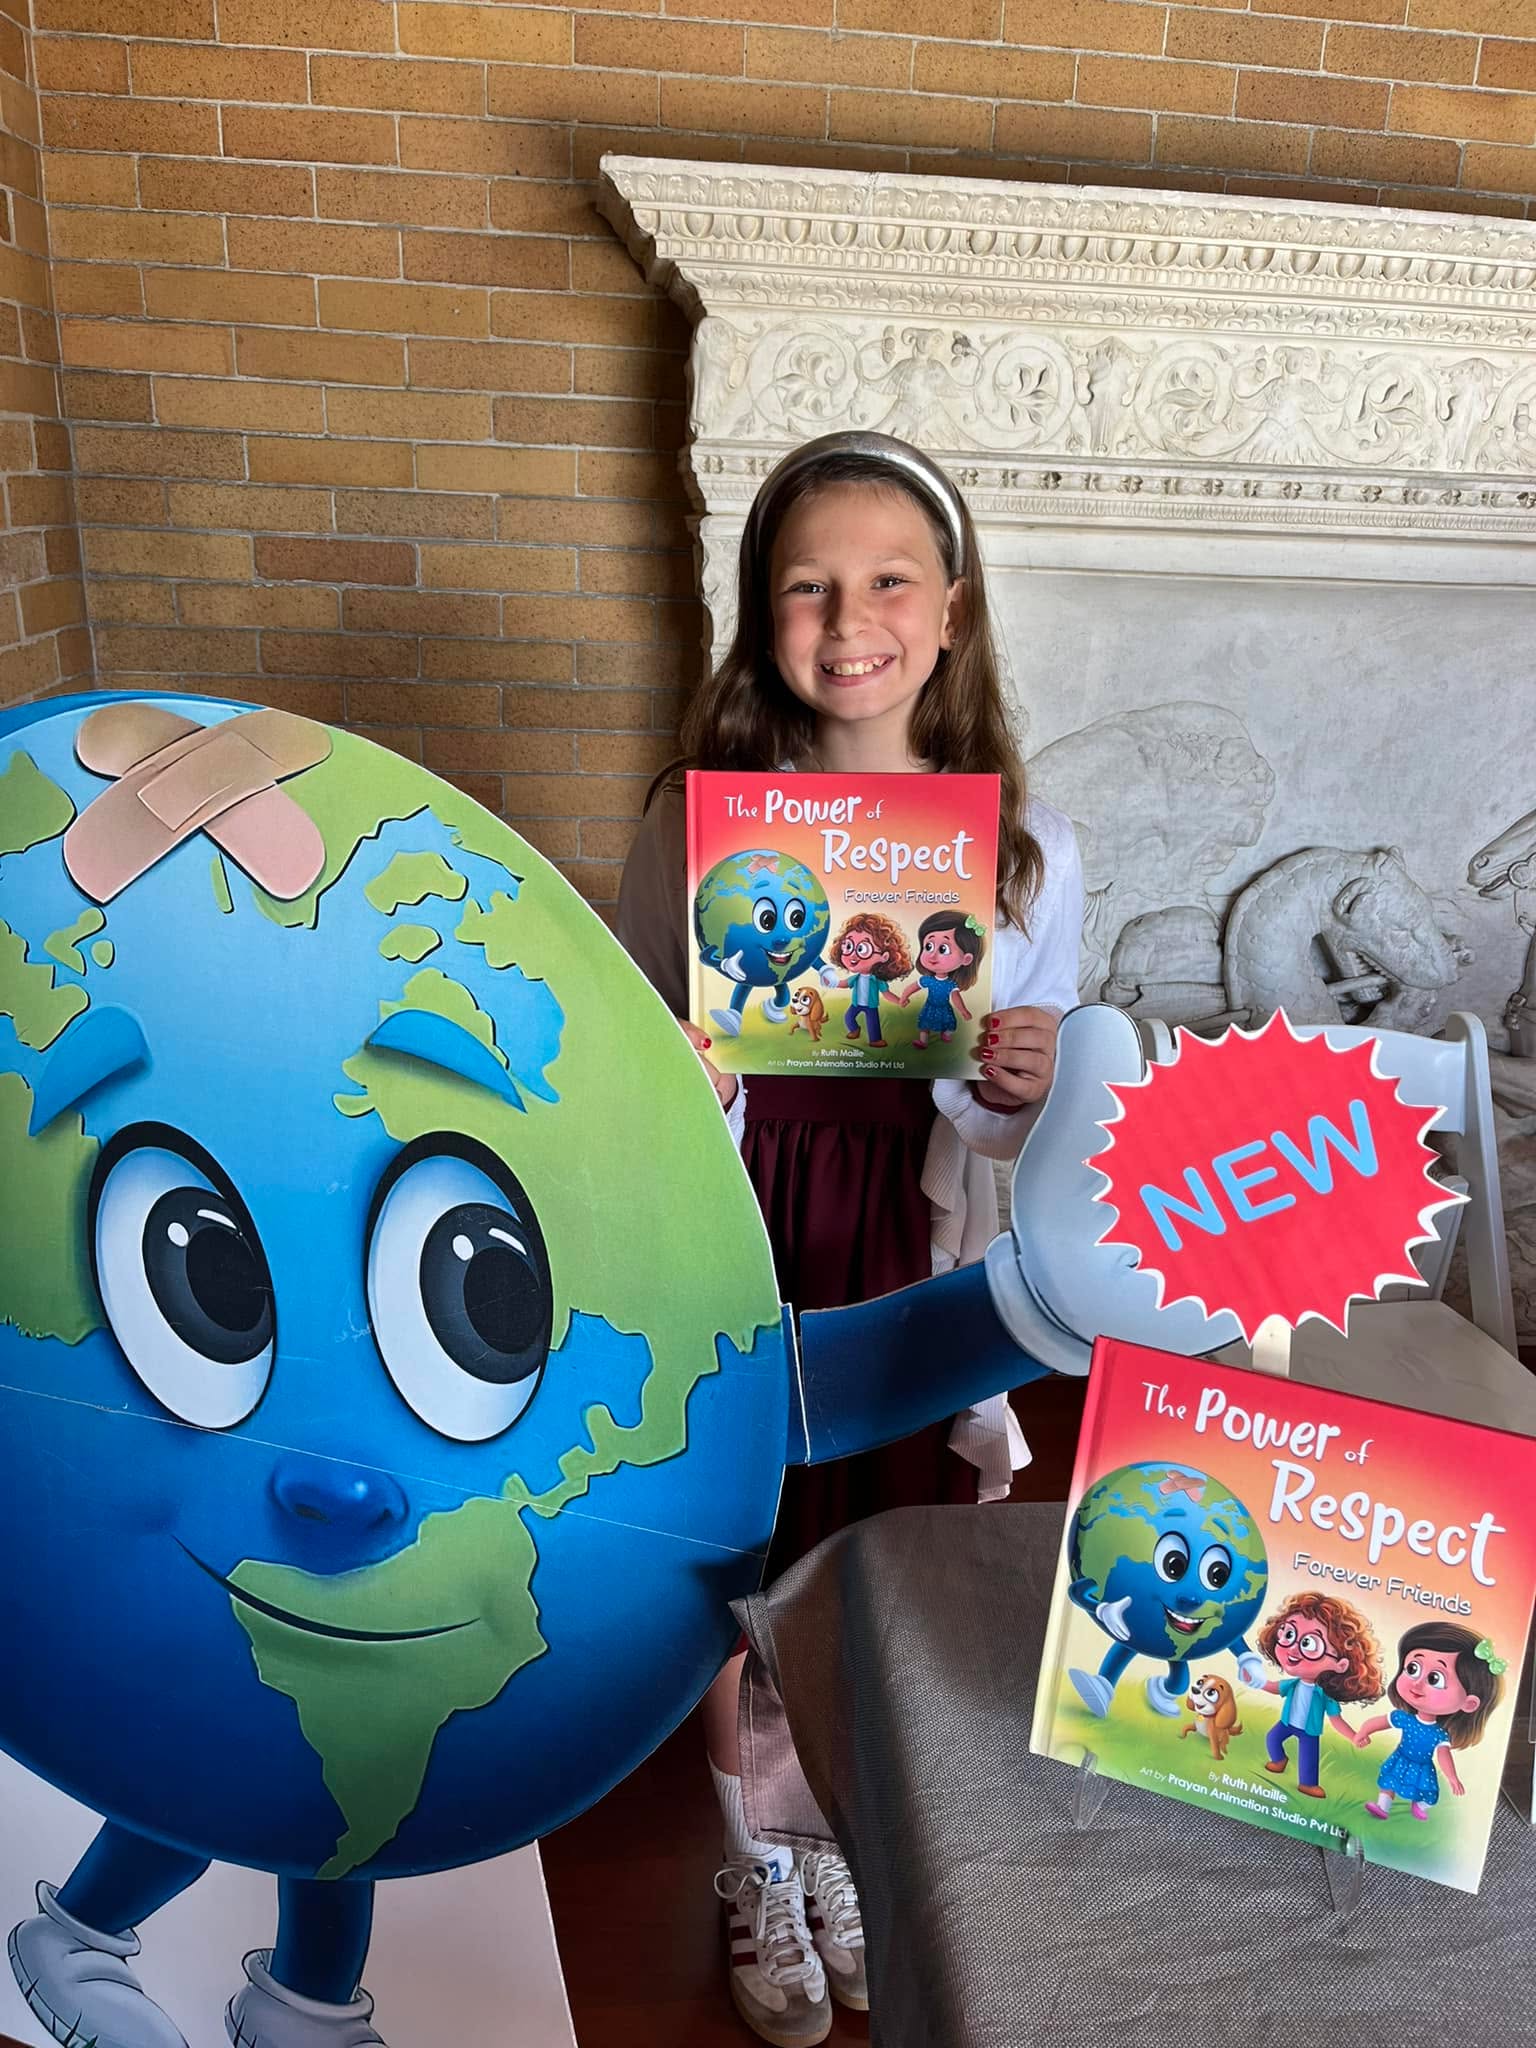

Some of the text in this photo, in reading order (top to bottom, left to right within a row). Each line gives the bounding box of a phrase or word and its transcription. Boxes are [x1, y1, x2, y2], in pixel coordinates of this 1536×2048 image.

[724, 788, 885, 825] The Power of
[819, 829, 974, 885] Respect
[844, 888, 960, 904] Forever Friends
[786, 1059, 814, 1069] Prayan
[815, 1060, 854, 1069] Animation
[855, 1060, 879, 1069] Studio
[880, 1060, 892, 1069] Pvt
[893, 1061, 905, 1069] Ltd
[820, 1049, 839, 1057] Ruth
[839, 1049, 865, 1058] Maille
[1139, 1099, 1379, 1251] NEW
[1141, 1382, 1374, 1465] The Power of
[1268, 1459, 1506, 1587] Respect
[1293, 1552, 1472, 1615] Forever Friends
[1139, 1767, 1153, 1777] Art
[1154, 1770, 1167, 1782] by
[1168, 1773, 1208, 1795] Prayan
[1210, 1788, 1270, 1815] Animation
[1271, 1806, 1308, 1827] Studio
[1309, 1818, 1328, 1833] Pvt
[1208, 1771, 1288, 1804] By Ruth Maille
